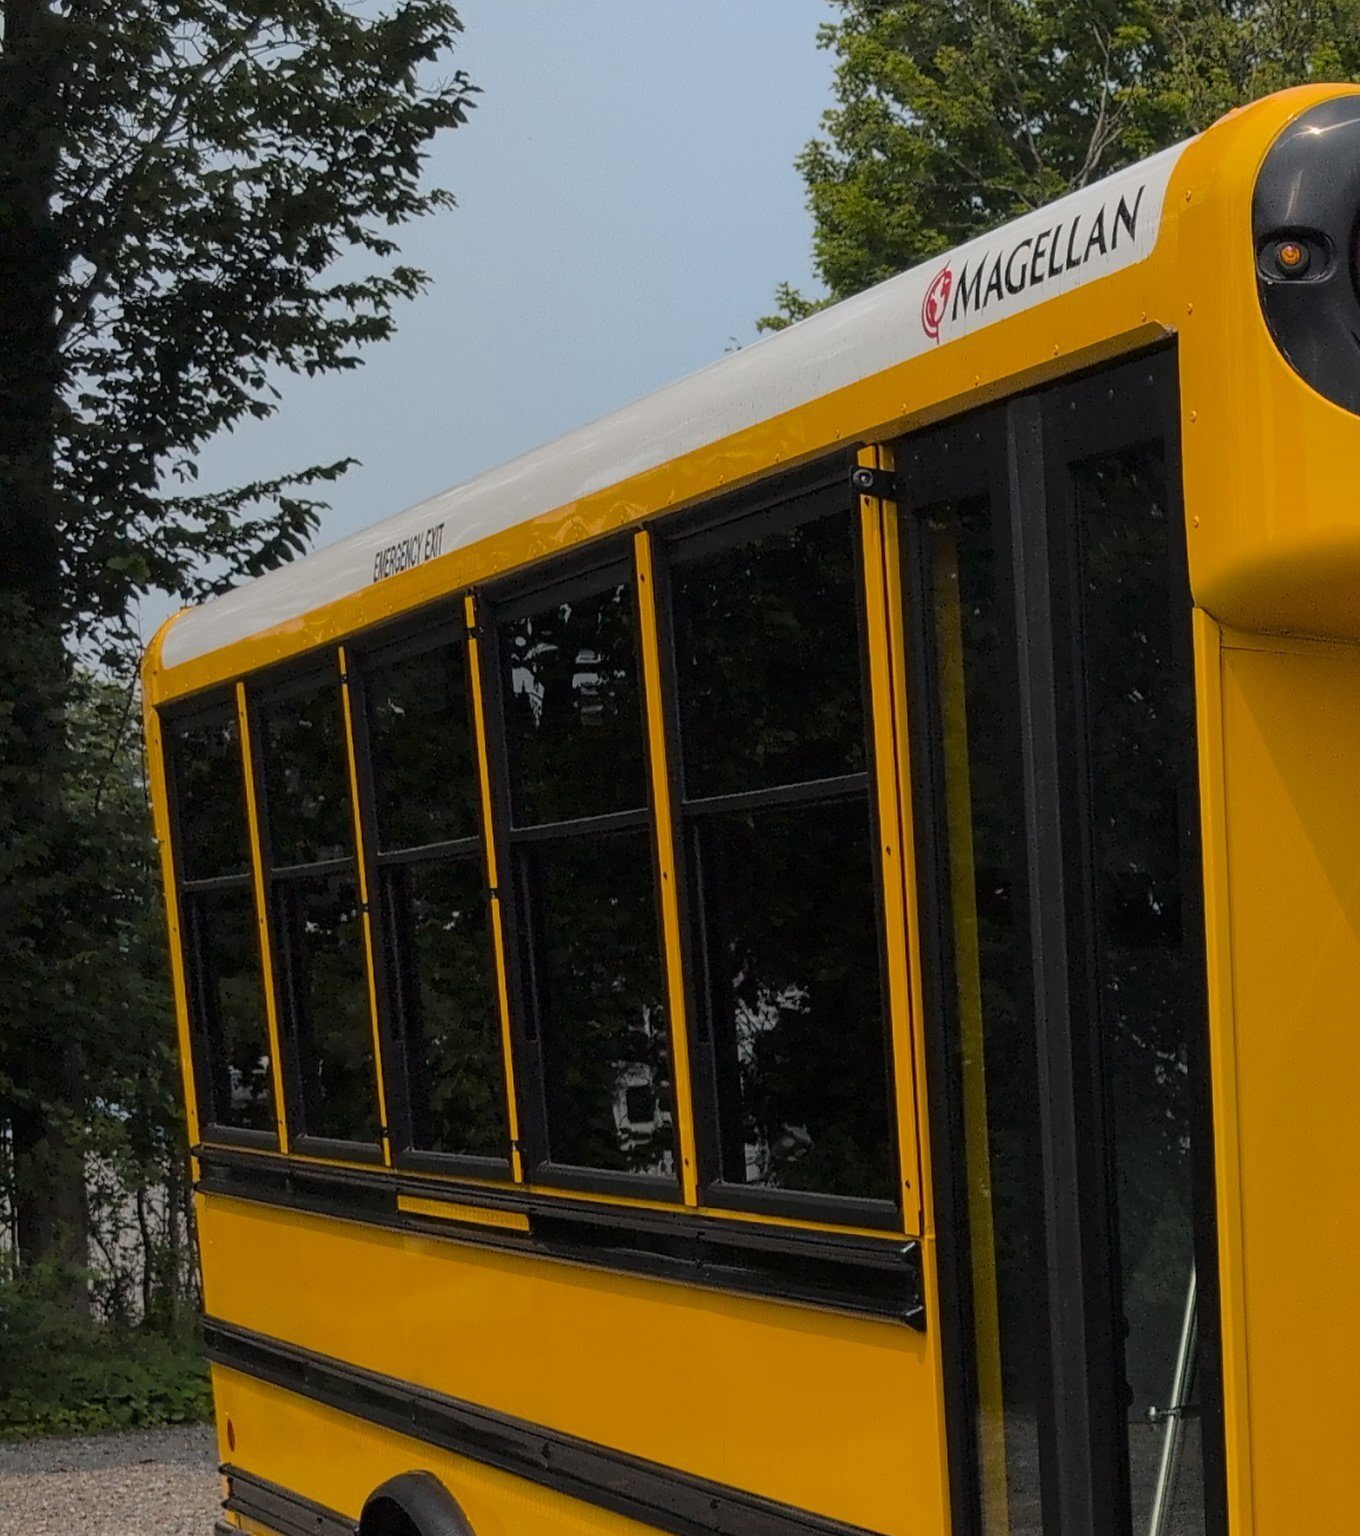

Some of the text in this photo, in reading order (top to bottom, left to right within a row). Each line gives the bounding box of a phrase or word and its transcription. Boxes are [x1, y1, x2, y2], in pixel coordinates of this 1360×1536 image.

[951, 184, 1146, 322] MAGELLAN
[373, 521, 445, 583] EMERGENCY EXIT
